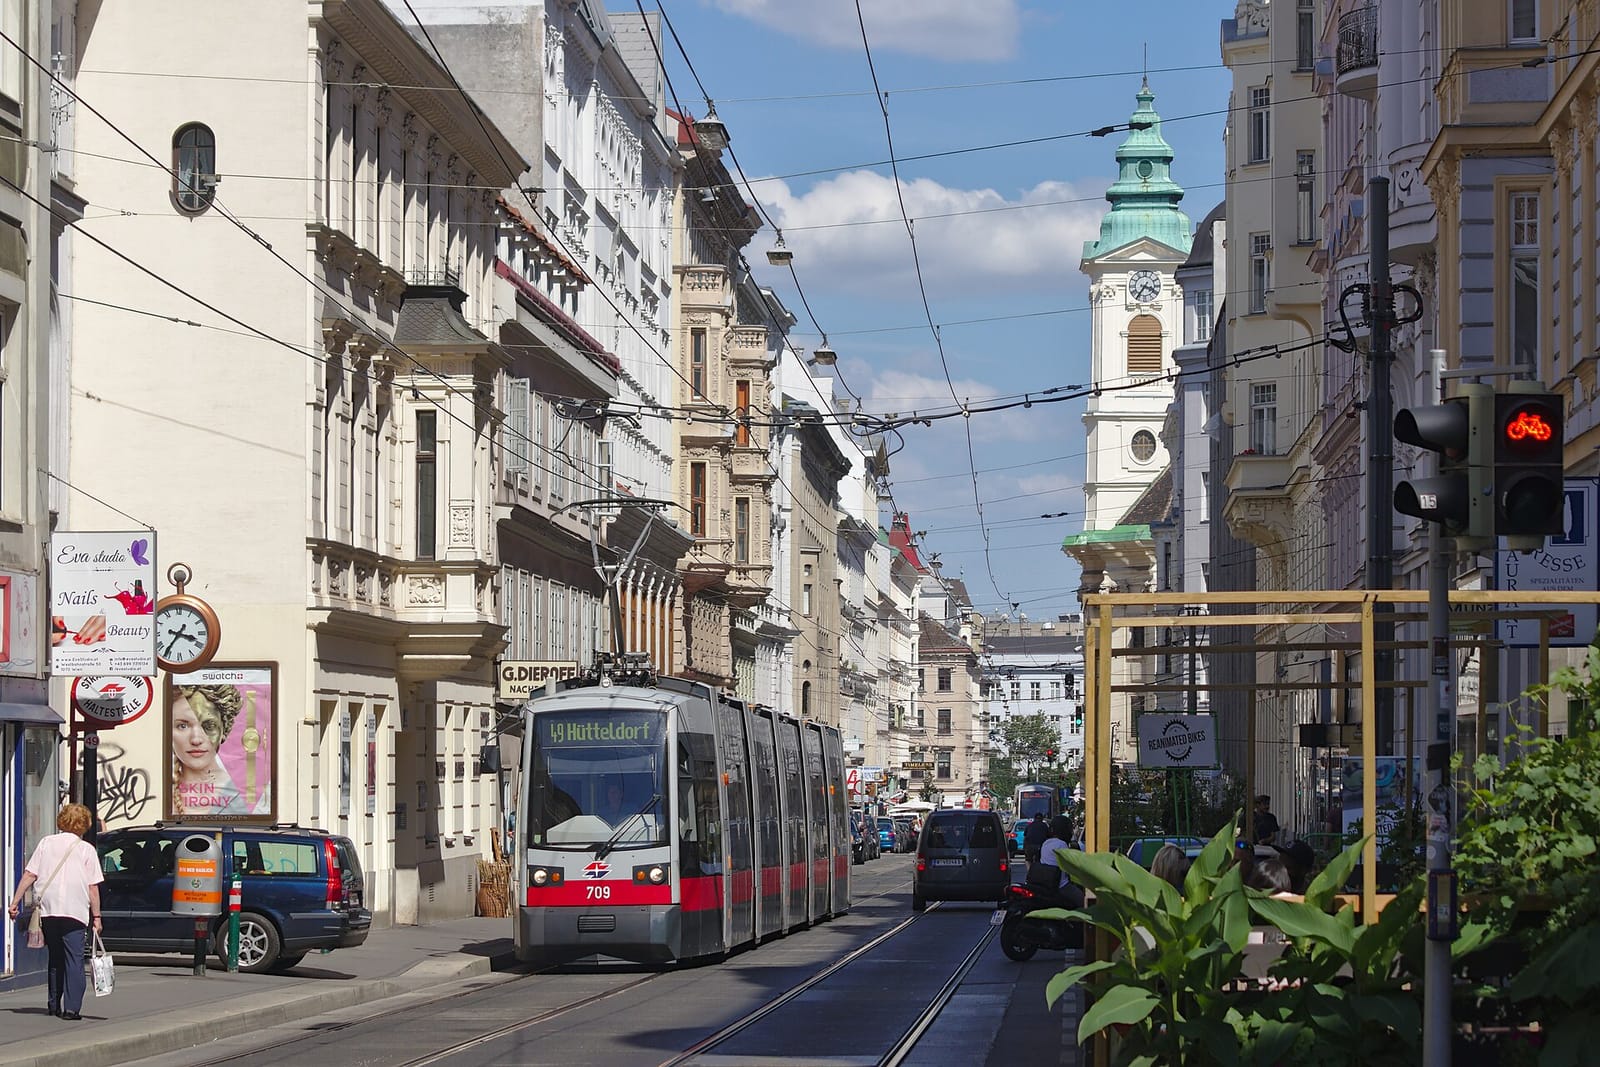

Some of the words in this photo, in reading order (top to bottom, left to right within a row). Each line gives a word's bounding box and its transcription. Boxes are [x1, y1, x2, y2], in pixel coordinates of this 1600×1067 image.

[1422, 495, 1436, 507] 15
[57, 545, 90, 564] Eva
[93, 549, 126, 562] studio
[58, 589, 98, 606] Nails
[108, 625, 150, 639] Beauty
[202, 672, 236, 680] swatch
[84, 698, 141, 718] HALTESTELLE
[550, 723, 564, 743] 49
[567, 721, 650, 741] Hütteldorf
[85, 737, 98, 746] 49
[1148, 734, 1188, 750] REANIMATED
[1187, 730, 1206, 744] BIKES
[179, 783, 215, 794] SKIN
[184, 796, 232, 807] IRONY
[586, 886, 610, 899] 709
